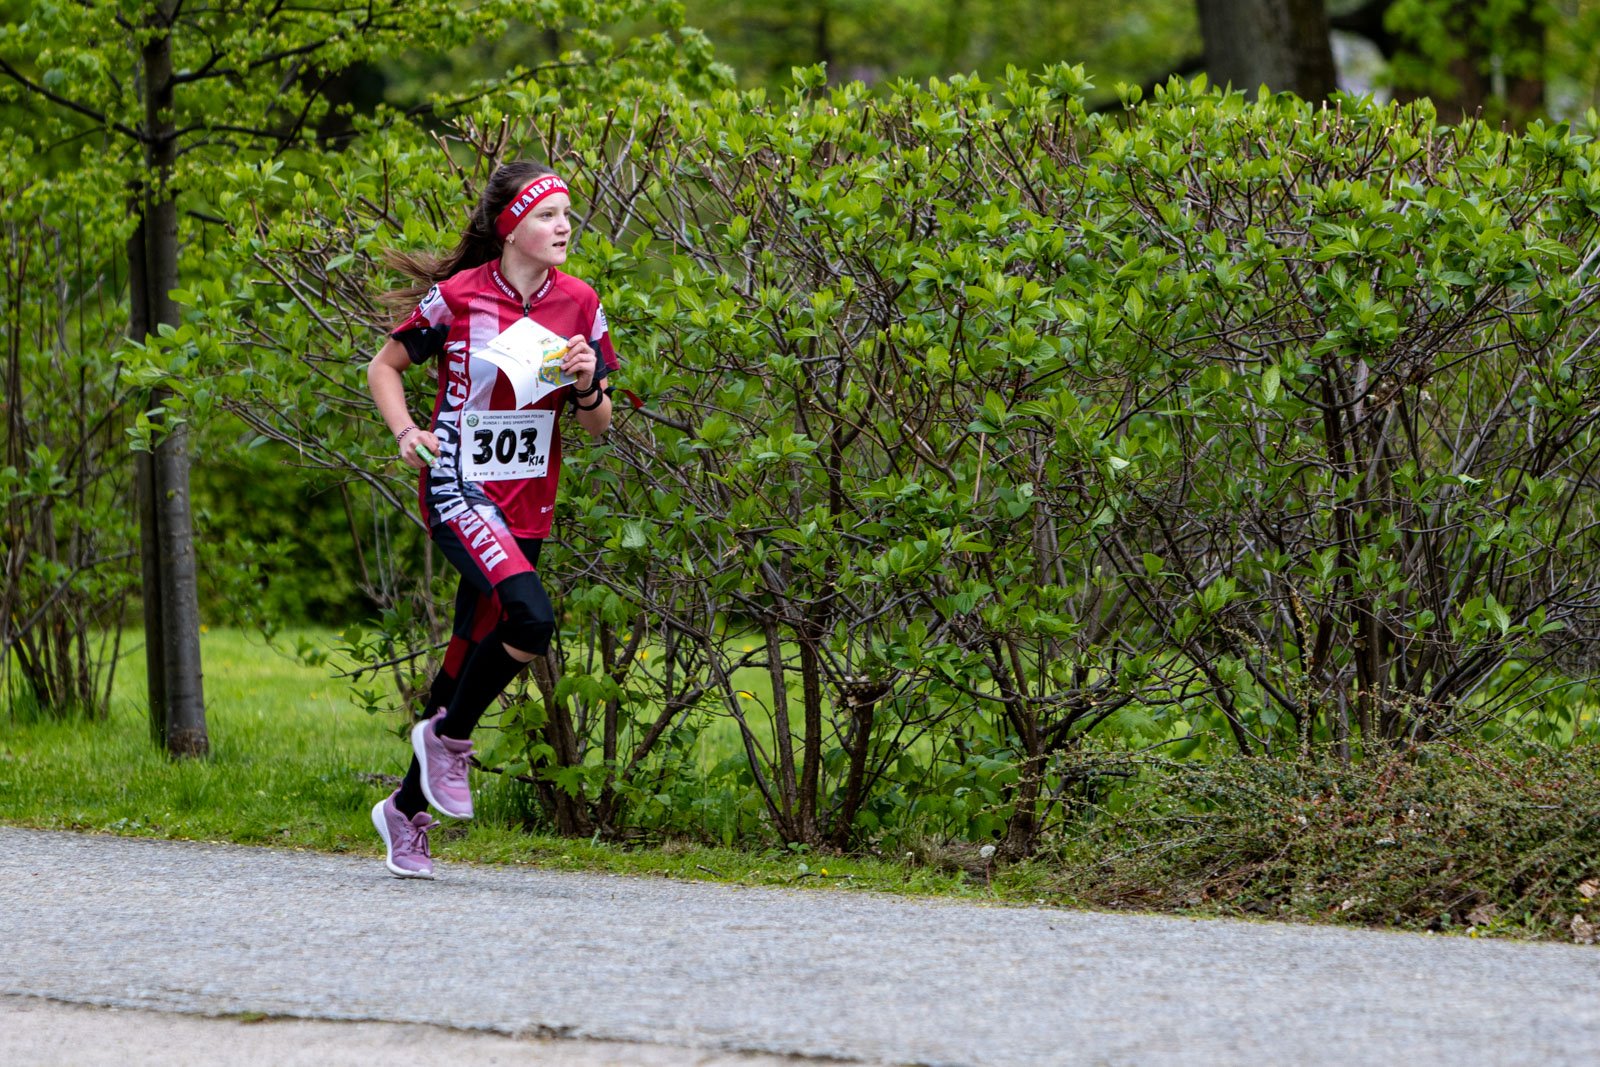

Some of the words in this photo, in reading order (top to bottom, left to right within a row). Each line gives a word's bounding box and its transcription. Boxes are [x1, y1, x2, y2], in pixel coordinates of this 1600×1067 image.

[472, 427, 537, 464] 303
[529, 455, 545, 466] K14
[450, 509, 508, 572] HAR
